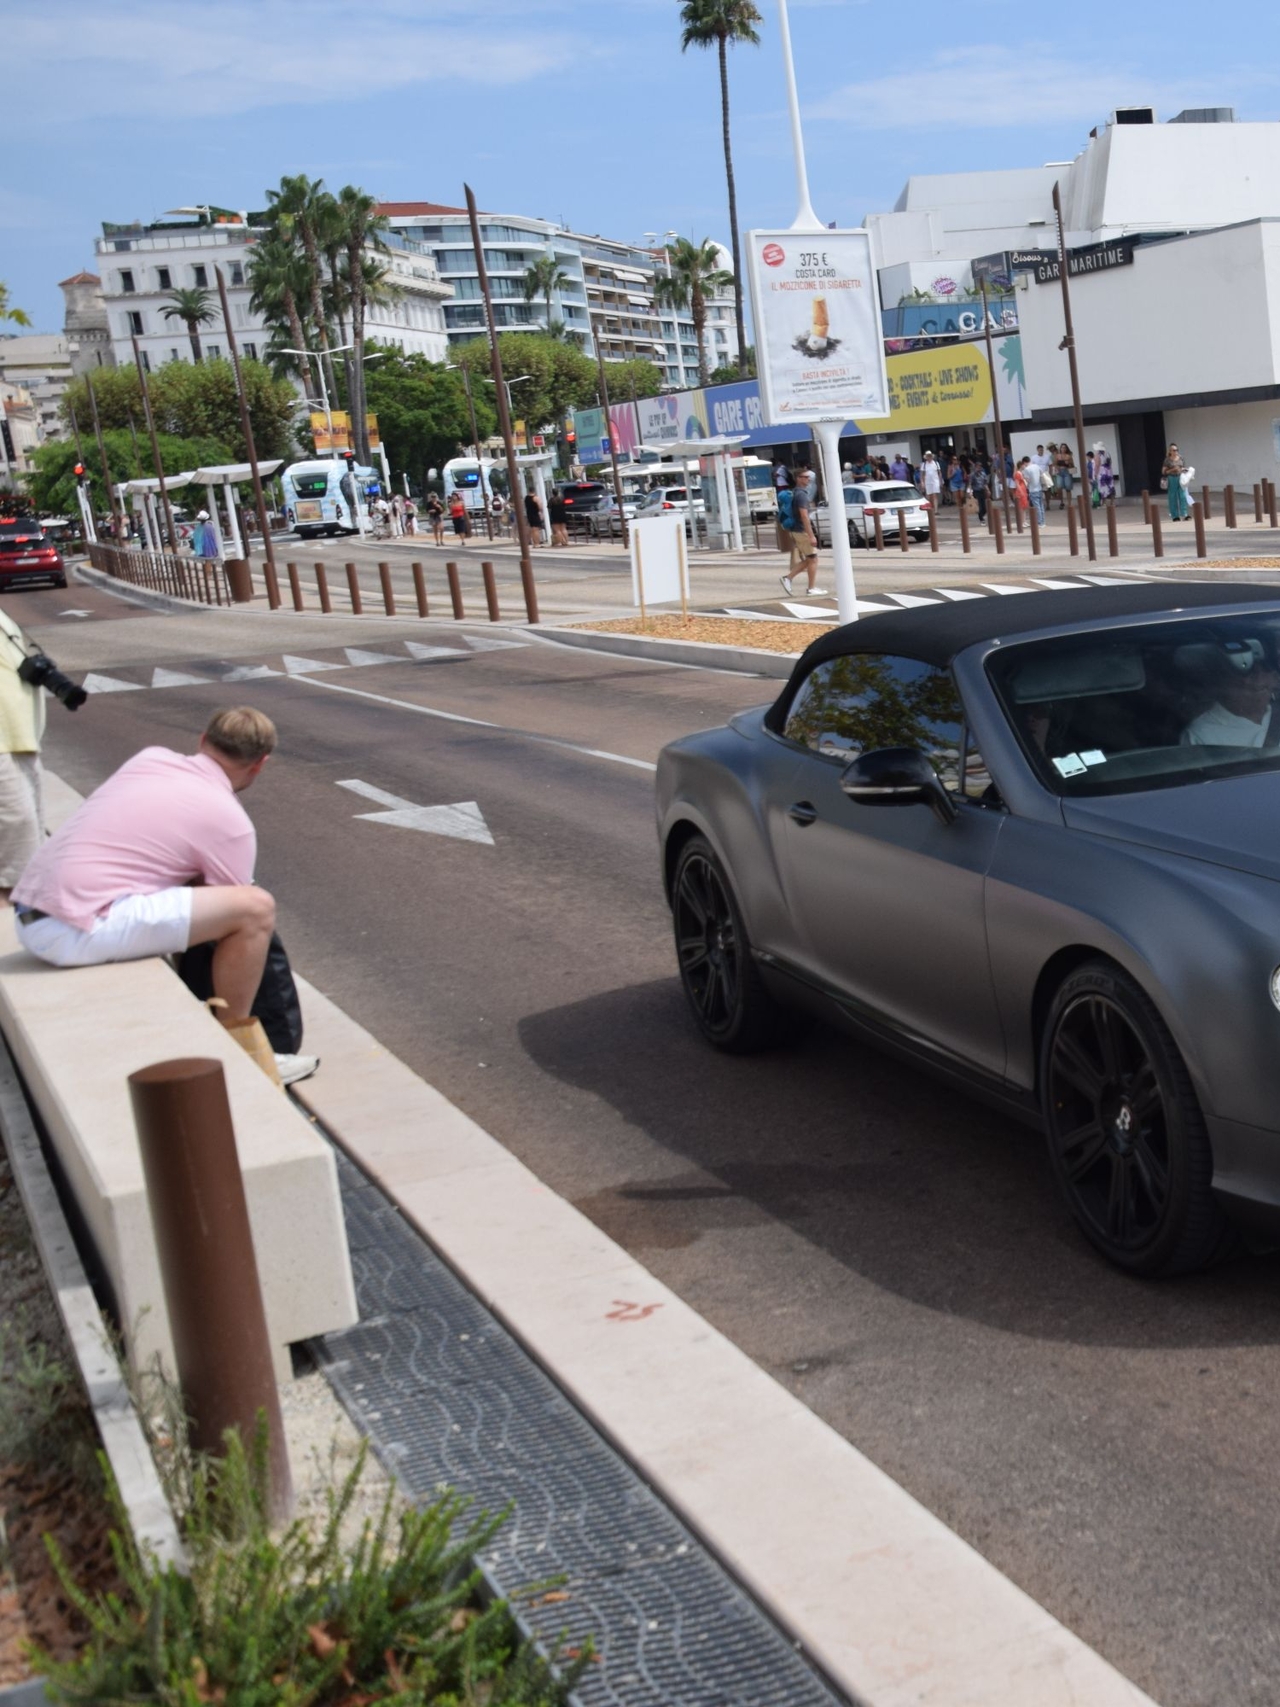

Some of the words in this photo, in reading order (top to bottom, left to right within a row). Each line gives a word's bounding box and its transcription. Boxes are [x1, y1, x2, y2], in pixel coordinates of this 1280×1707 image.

[799, 252, 819, 267] 375
[821, 252, 829, 266] €
[1012, 251, 1042, 264] Bisous
[1038, 262, 1060, 281] GAR
[1070, 248, 1124, 273] MARITIME
[795, 269, 816, 279] COSTA
[779, 281, 818, 292] MOZZICONE
[819, 280, 826, 290] DI
[827, 279, 862, 290] SIGARETTA
[899, 371, 933, 392] COCKTAILS
[955, 363, 979, 384] SHOWS
[905, 389, 930, 409] EVENTS
[713, 398, 744, 434] GARE
